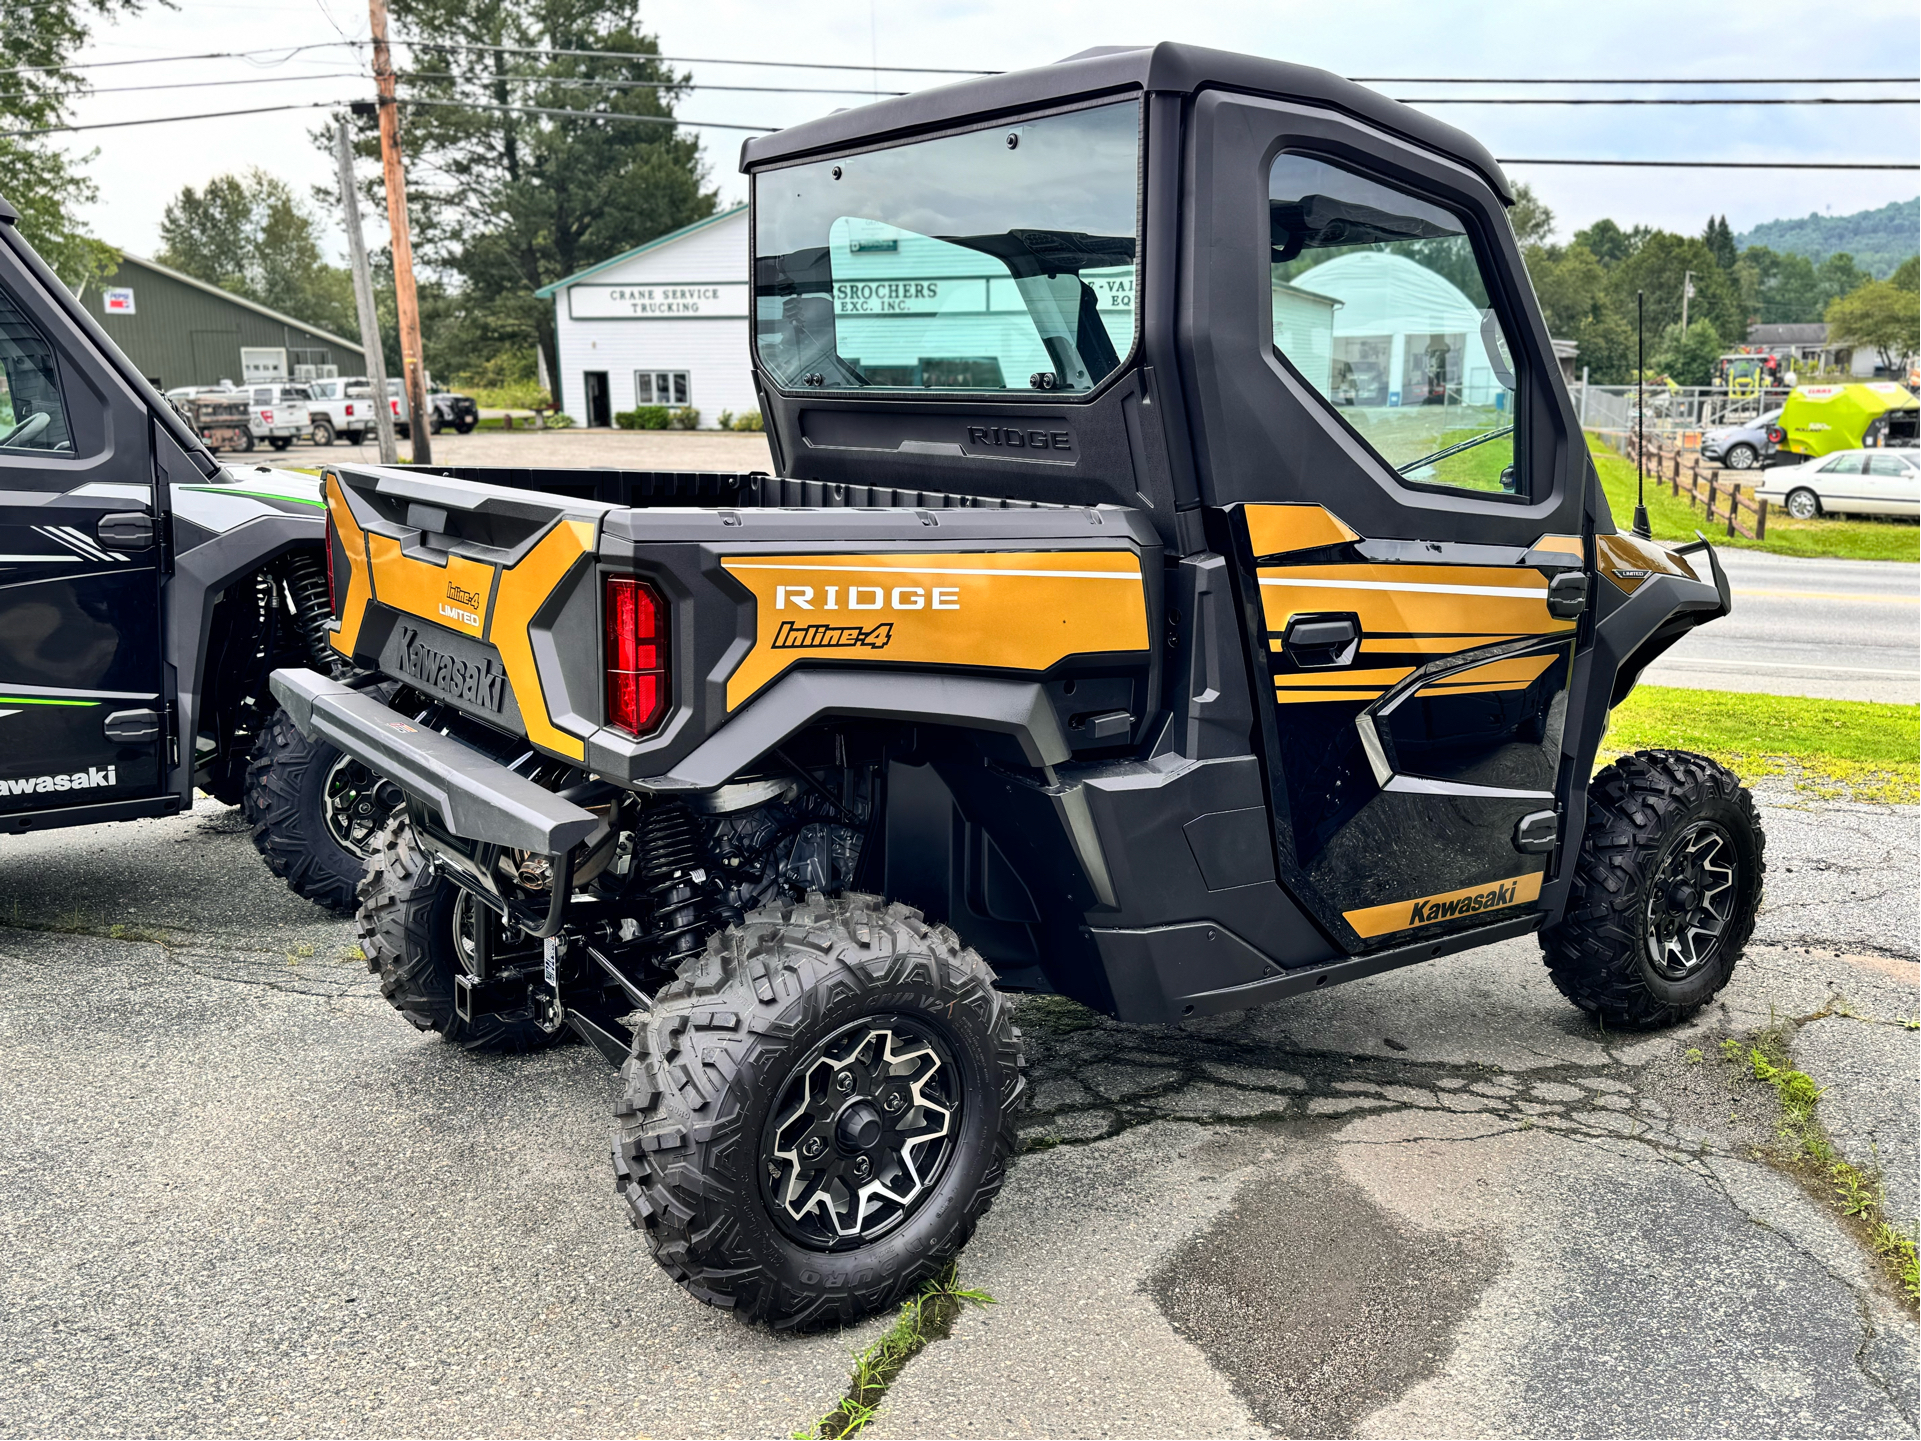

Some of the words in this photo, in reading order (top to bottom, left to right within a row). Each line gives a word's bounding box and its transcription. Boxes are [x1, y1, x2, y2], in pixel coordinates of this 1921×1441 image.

[610, 289, 656, 301] CRANE
[662, 288, 720, 300] SERVICE
[834, 283, 938, 301] SROCHERS
[631, 302, 700, 314] TRUCKING
[840, 301, 873, 313] EXC.
[880, 300, 911, 312] INC.
[966, 425, 1072, 451] RIDGE
[446, 580, 480, 611] Inline-4
[775, 585, 961, 610] RIDGE
[438, 602, 480, 627] LIMITED
[770, 620, 895, 650] Inline-4
[397, 625, 508, 714] Kawasaki
[0, 764, 116, 797] awasaki
[1408, 880, 1518, 926] Kawasaki
[918, 994, 944, 1014] V2
[799, 1252, 900, 1290] DURO
